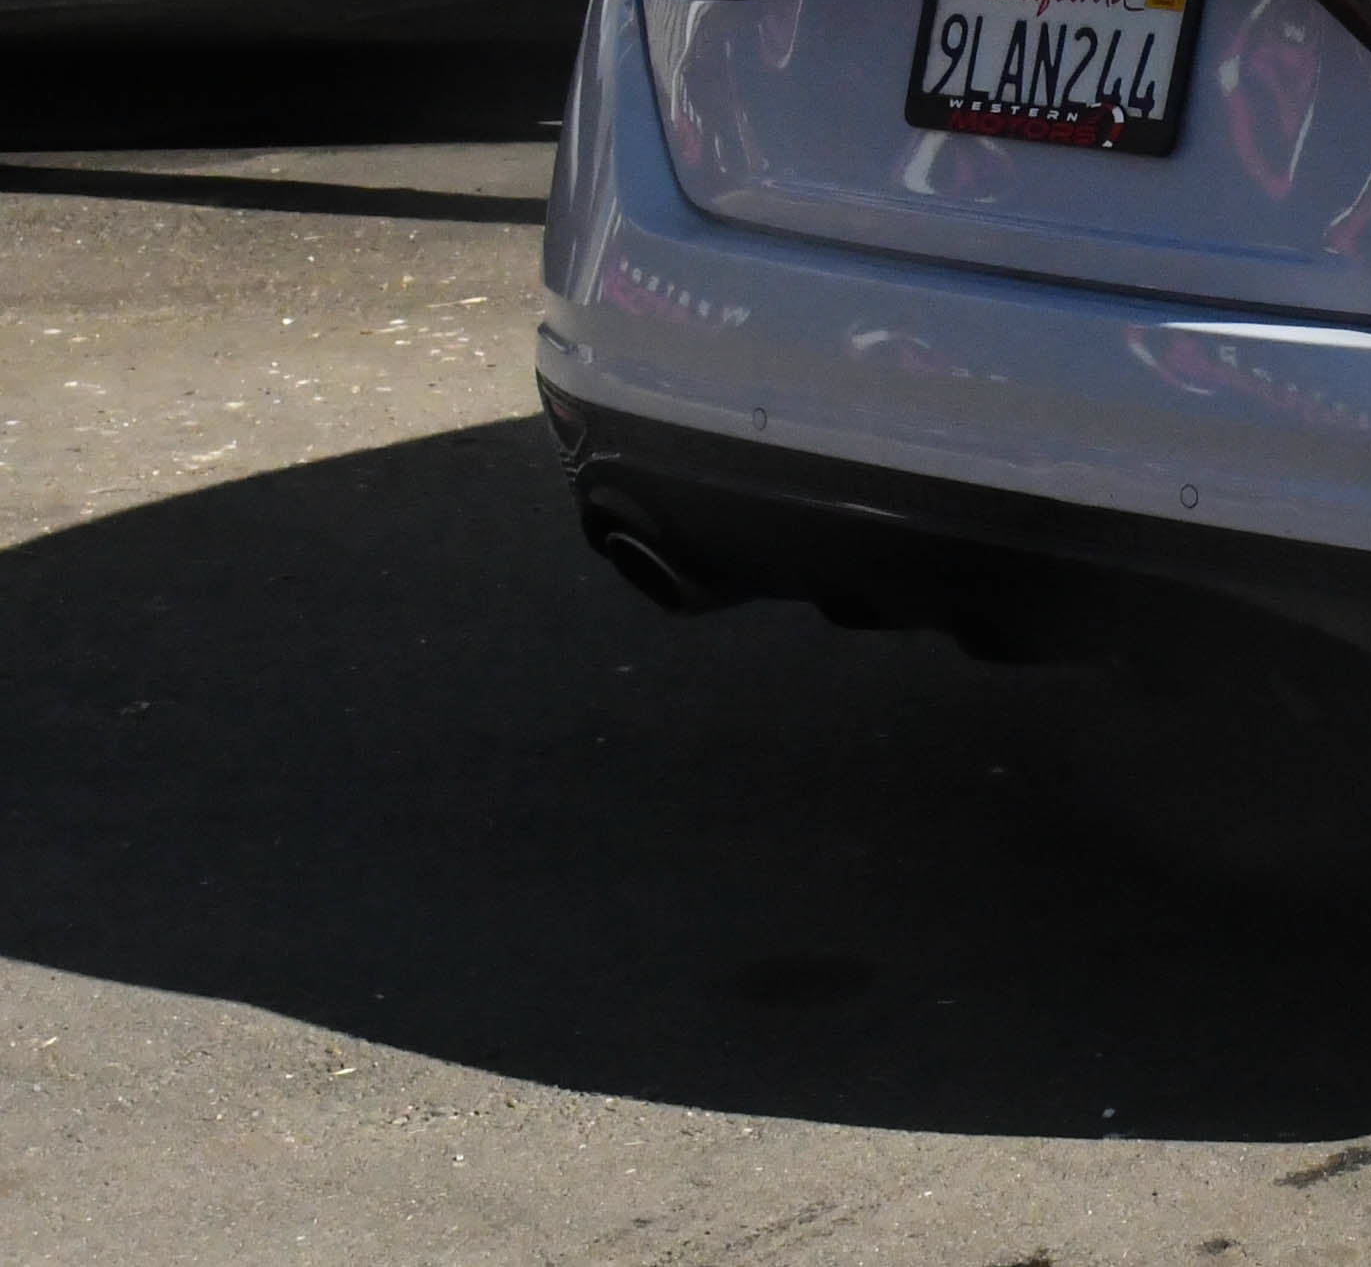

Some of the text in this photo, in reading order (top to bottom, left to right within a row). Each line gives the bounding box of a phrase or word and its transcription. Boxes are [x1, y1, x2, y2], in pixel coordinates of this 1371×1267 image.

[929, 13, 1156, 118] 9LAN244
[949, 98, 1080, 122] WESTERN
[950, 111, 1097, 146] MOTORS
